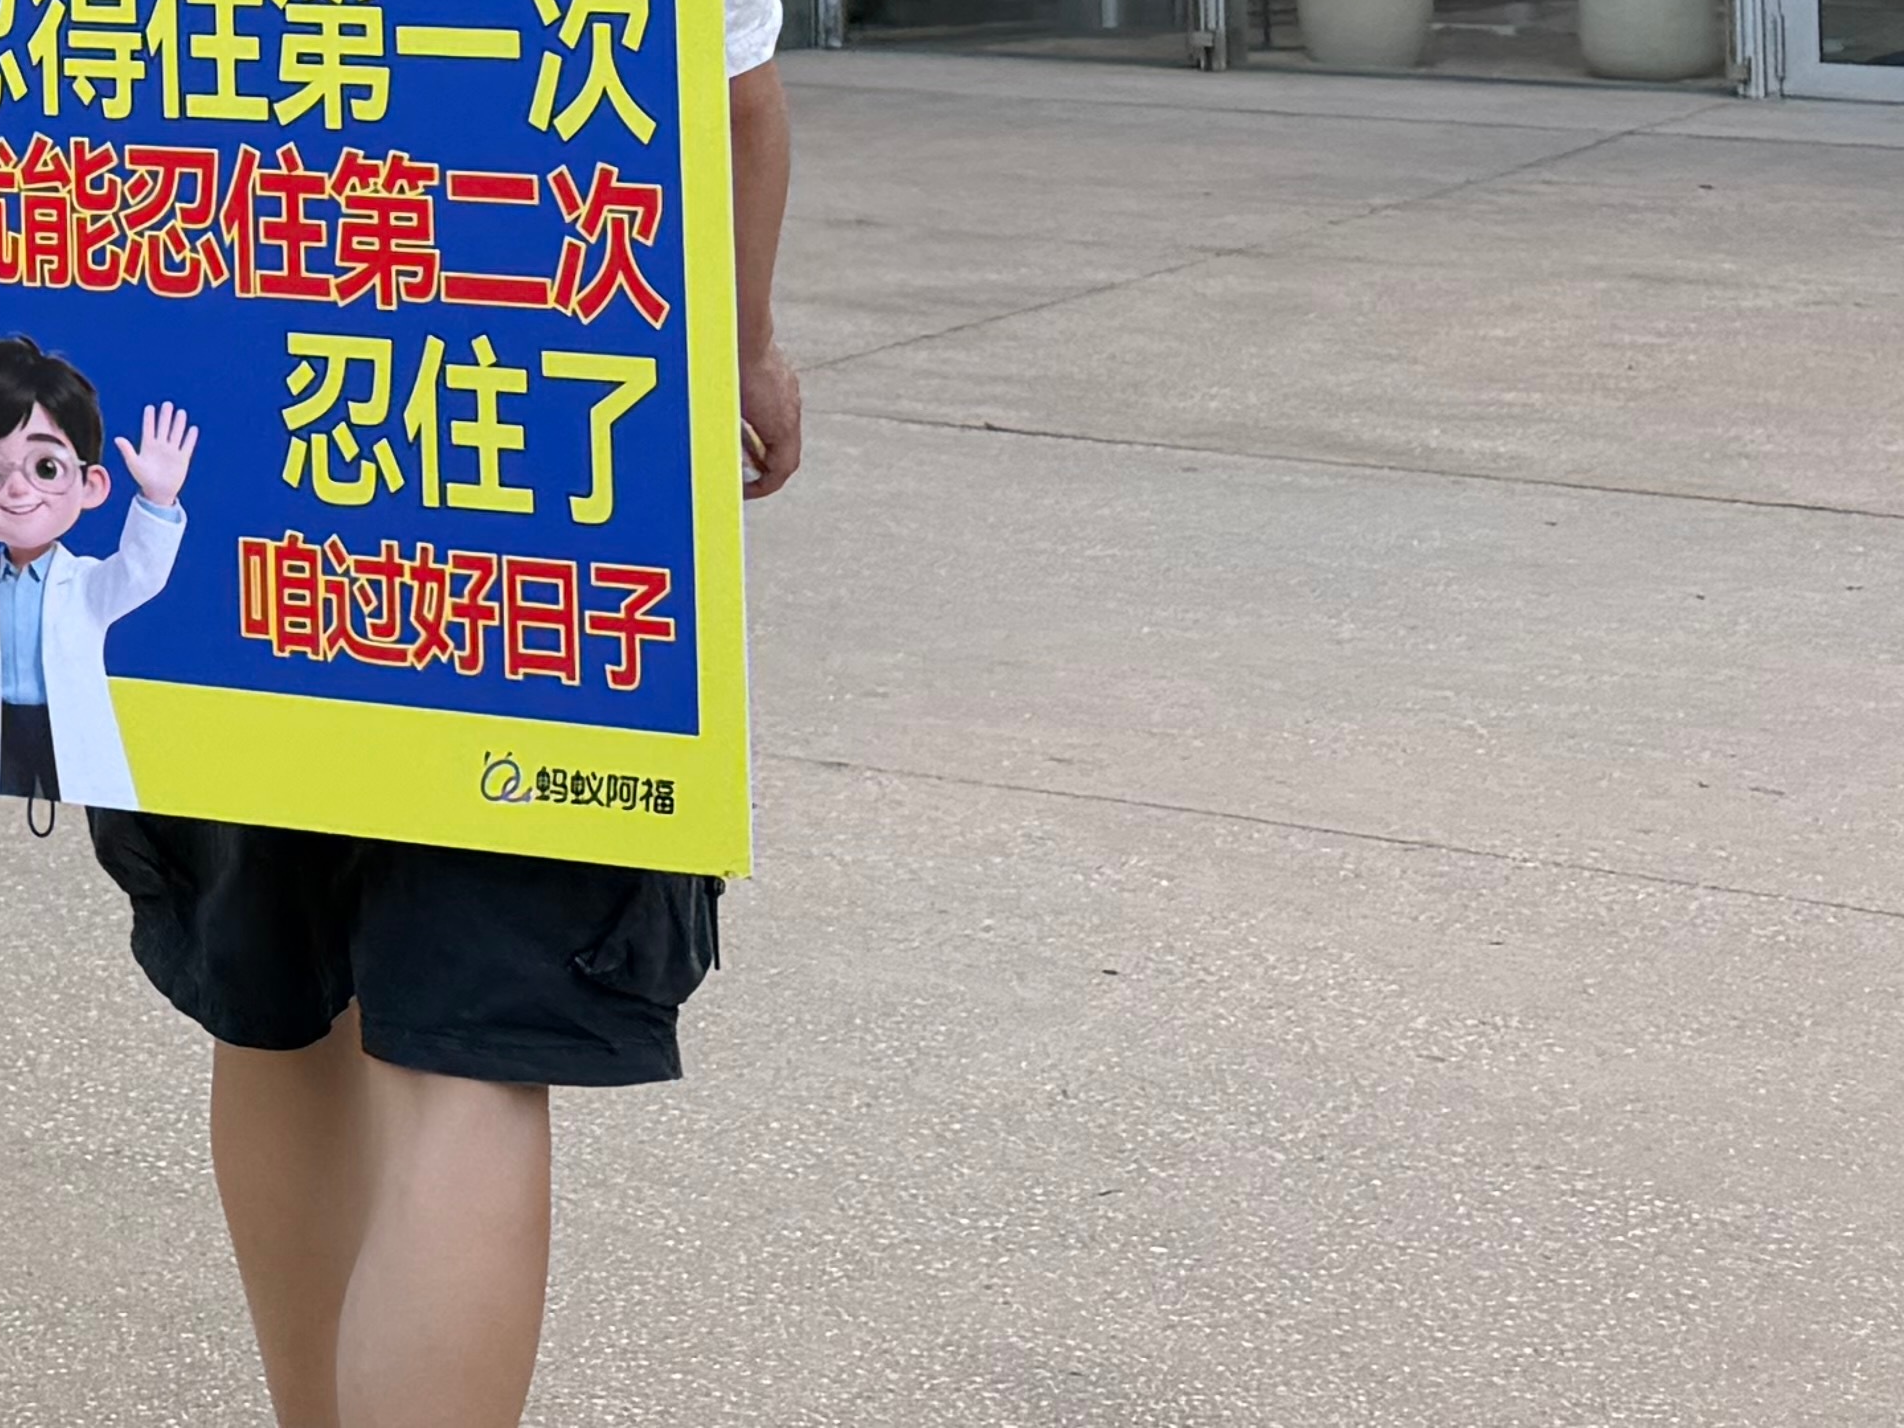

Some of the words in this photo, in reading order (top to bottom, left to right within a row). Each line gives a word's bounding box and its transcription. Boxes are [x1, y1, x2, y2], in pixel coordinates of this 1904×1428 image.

[281, 331, 658, 524] 忍住了
[238, 531, 676, 691] 咱过好日子
[535, 766, 675, 815] 蚂蚁阿福
